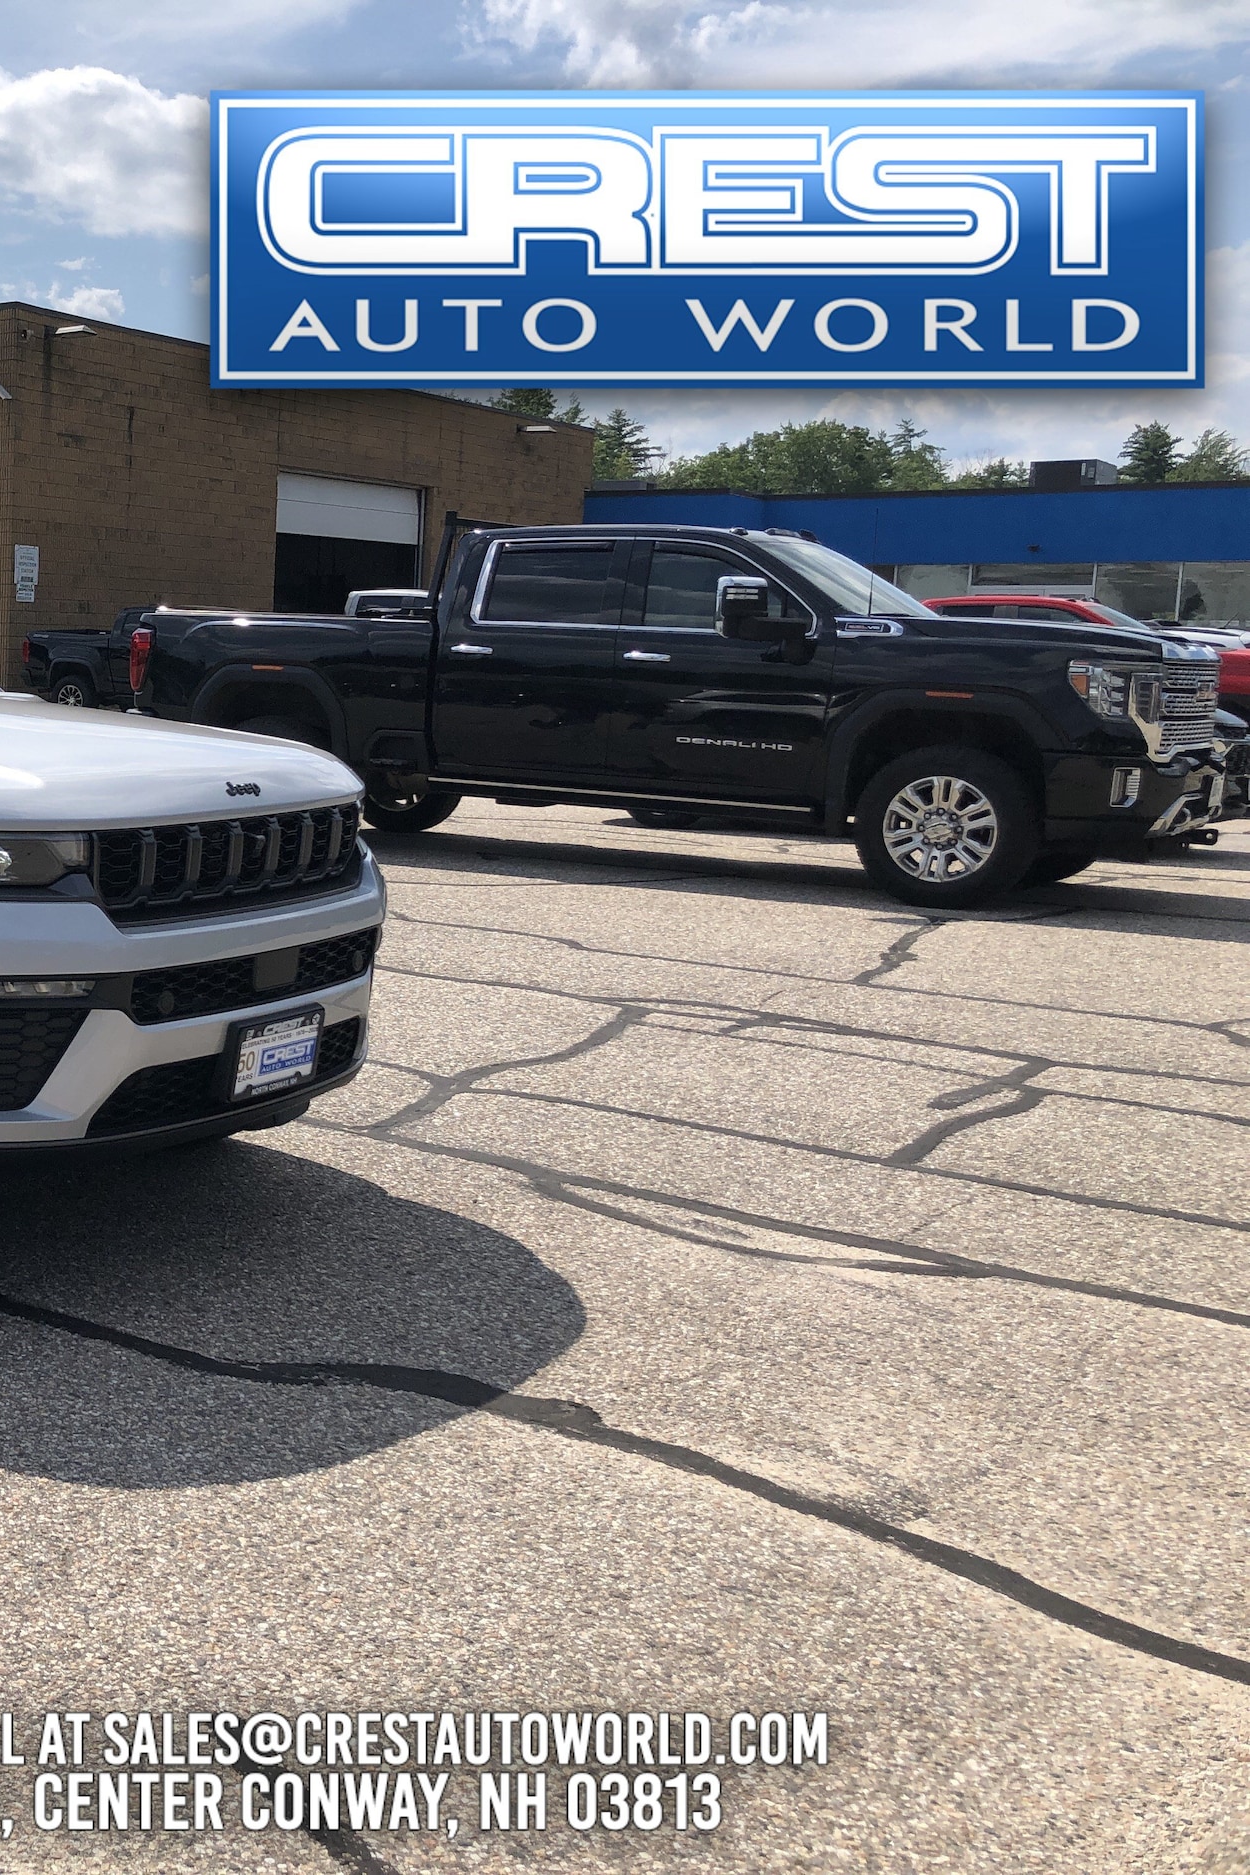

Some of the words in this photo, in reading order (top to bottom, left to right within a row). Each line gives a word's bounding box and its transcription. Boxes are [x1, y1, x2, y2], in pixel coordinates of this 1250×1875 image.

[675, 736, 756, 748] DENALI
[761, 742, 793, 751] HD
[225, 781, 261, 797] Jeep
[263, 1016, 305, 1036] CREST
[278, 1033, 293, 1041] YEARS
[263, 1041, 315, 1066] CREST
[237, 1050, 255, 1074] 50
[261, 1062, 282, 1073] AUTO
[285, 1055, 311, 1067] WORLD
[237, 1073, 254, 1083] EARS
[251, 1086, 268, 1096] NORTH
